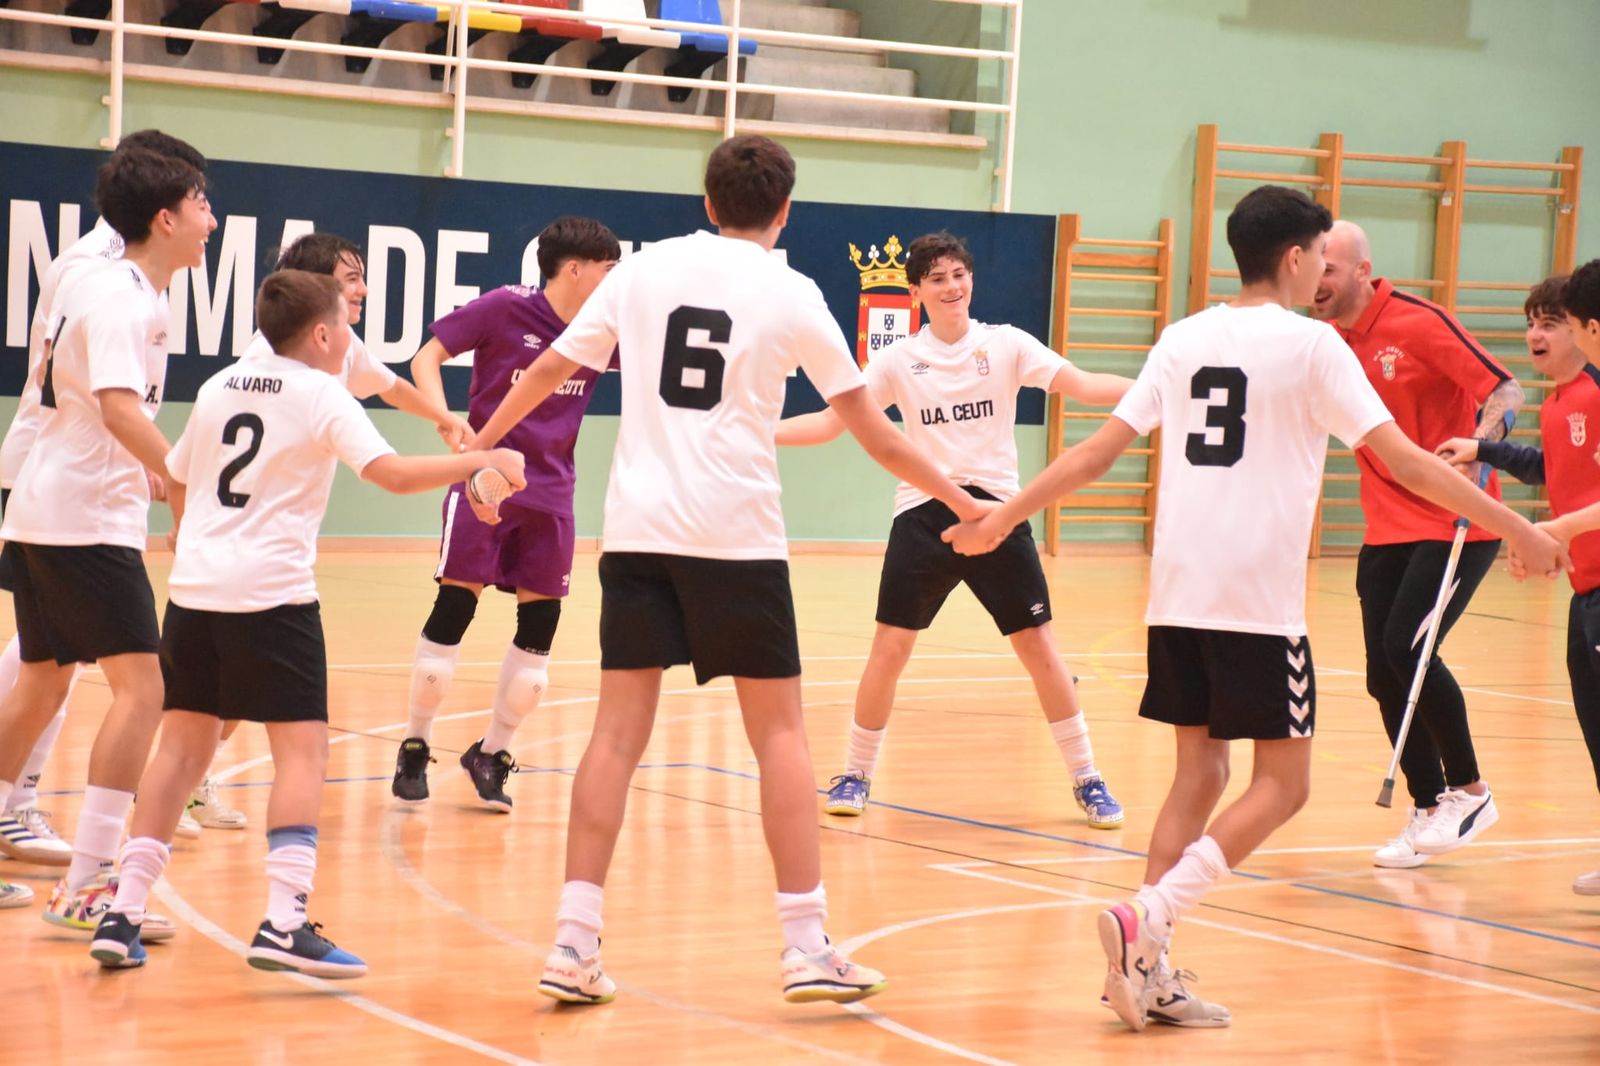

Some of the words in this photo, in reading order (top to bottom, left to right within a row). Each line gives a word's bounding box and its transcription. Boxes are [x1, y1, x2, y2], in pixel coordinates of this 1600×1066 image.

[363, 224, 489, 367] DE
[224, 376, 283, 394] ALVARO
[659, 304, 733, 411] 6
[217, 412, 265, 508] 2
[921, 407, 949, 425] U.A.
[952, 399, 994, 421] CEUTI
[1185, 366, 1249, 468] 3
